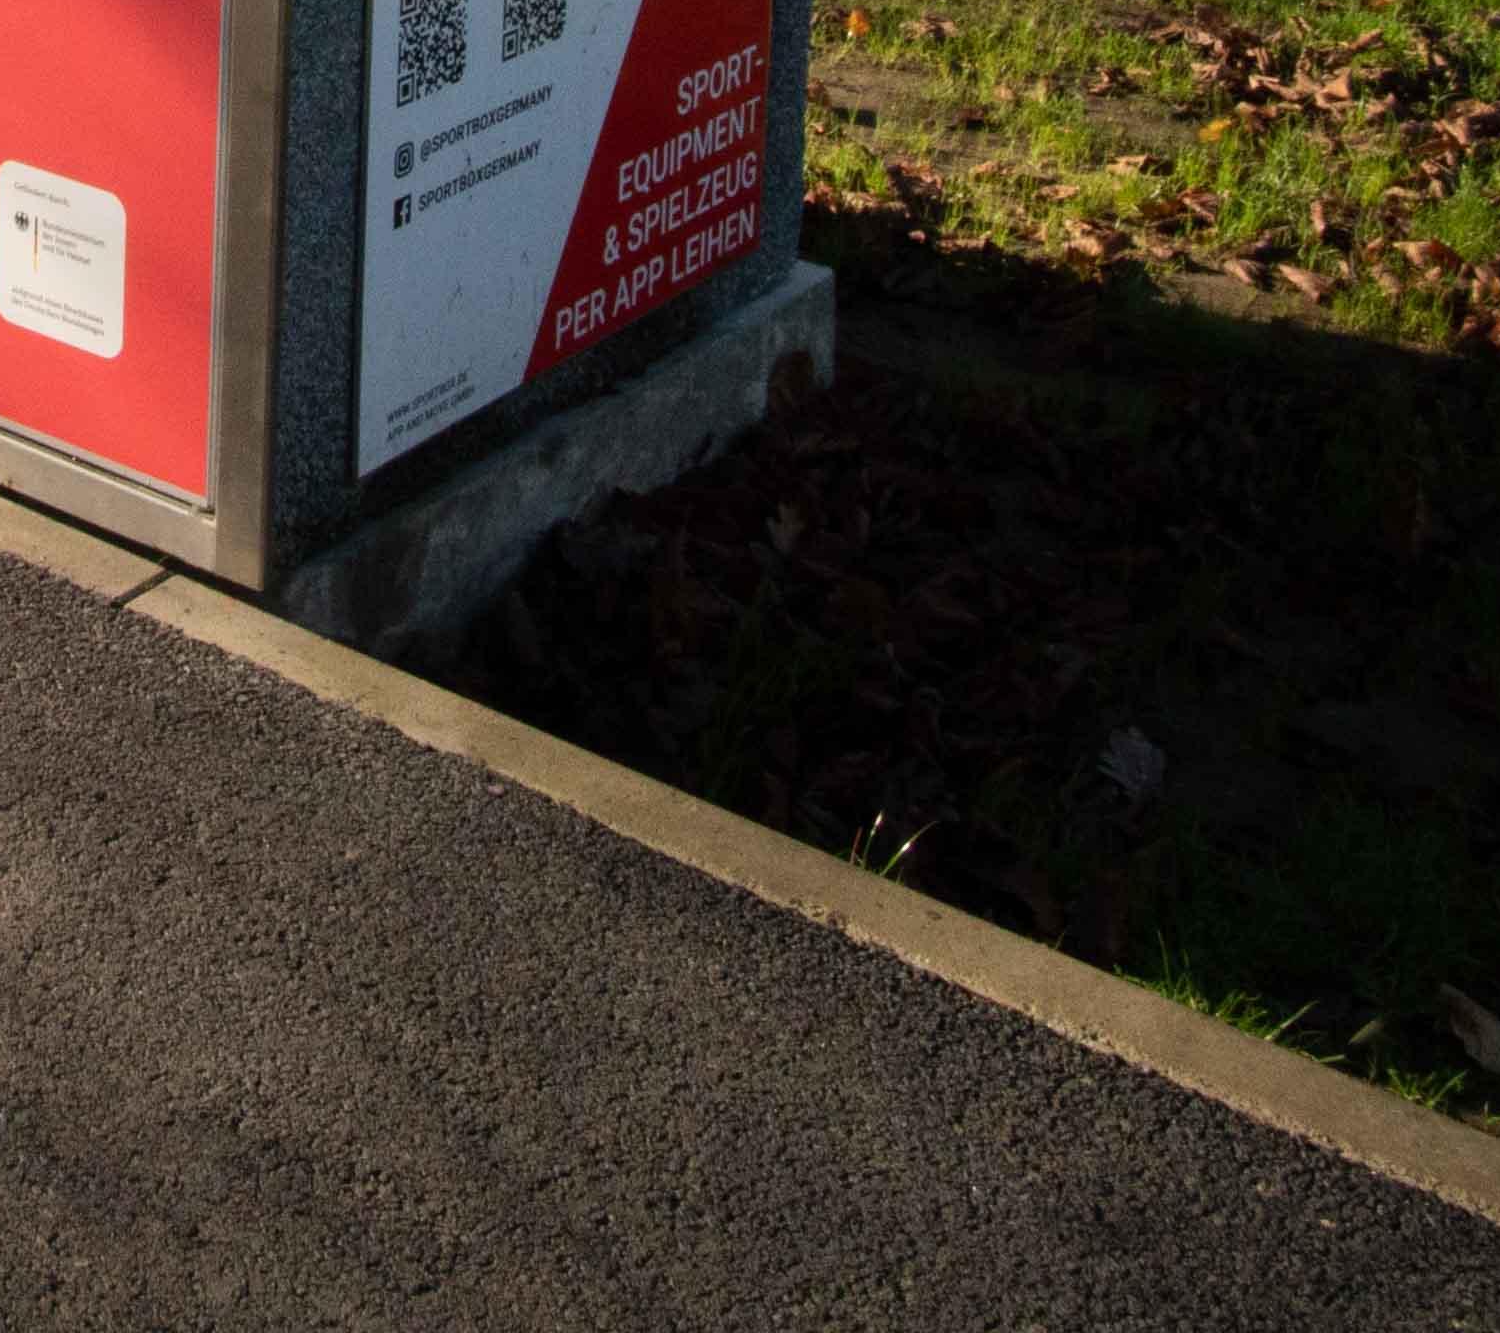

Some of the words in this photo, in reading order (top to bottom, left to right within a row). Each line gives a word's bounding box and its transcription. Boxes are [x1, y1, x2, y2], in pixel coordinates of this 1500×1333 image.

[420, 83, 553, 163] @SPORTBOXGERMANY
[676, 43, 764, 117] SPORT-
[417, 137, 543, 212] SPORTBOXGERMANY
[617, 95, 762, 204] EQUIPMENT
[602, 224, 622, 267] &
[626, 150, 759, 253] SPIELZEUG
[554, 287, 607, 351] PER
[611, 254, 666, 319] APP
[671, 203, 756, 284] LEIHEN
